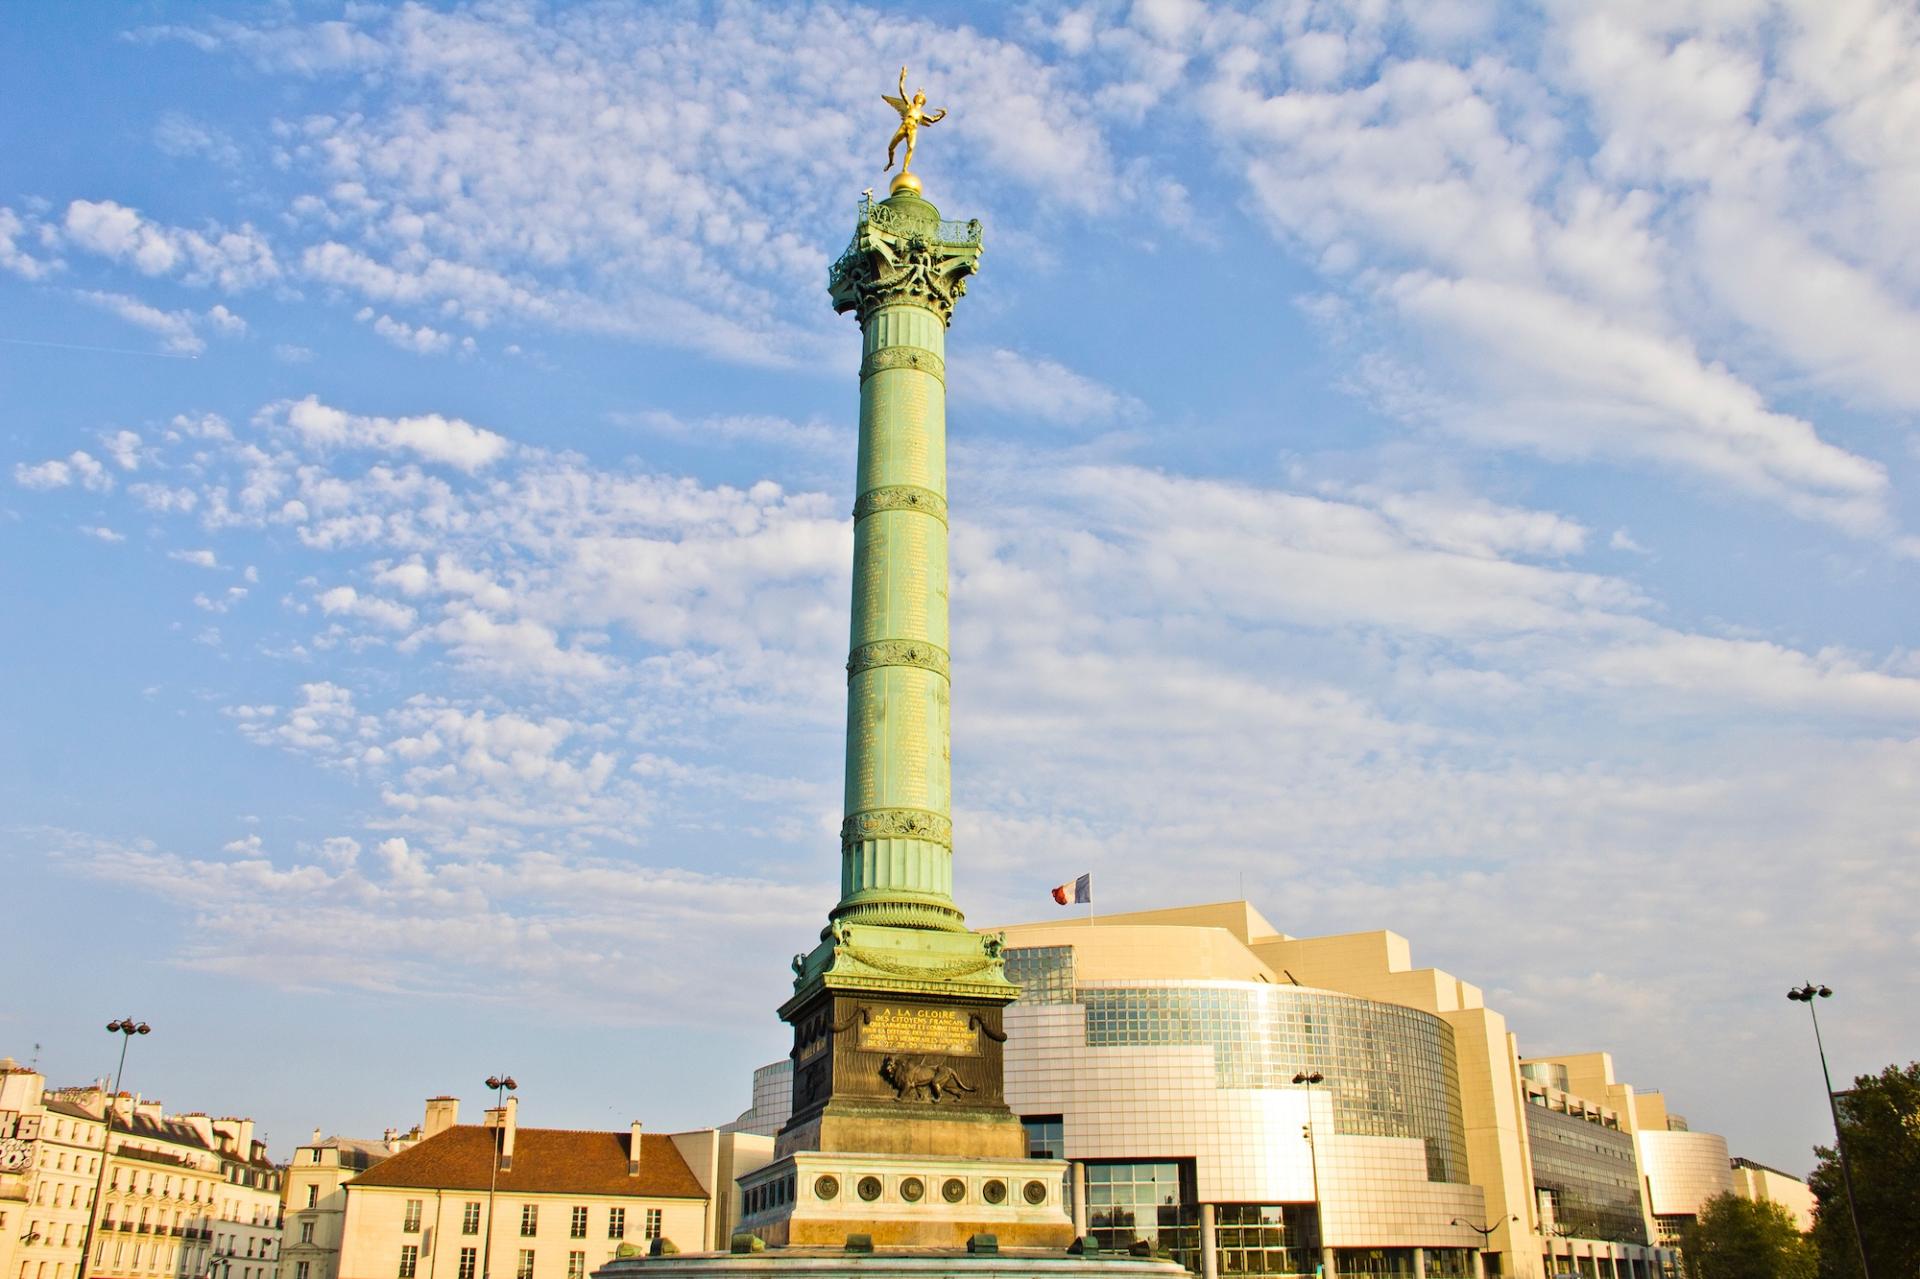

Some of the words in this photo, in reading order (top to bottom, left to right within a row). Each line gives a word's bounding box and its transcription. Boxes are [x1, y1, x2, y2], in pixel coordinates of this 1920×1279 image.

[884, 1008, 890, 1016] A
[898, 1009, 910, 1017] LA
[918, 1010, 956, 1019] GLOIRE
